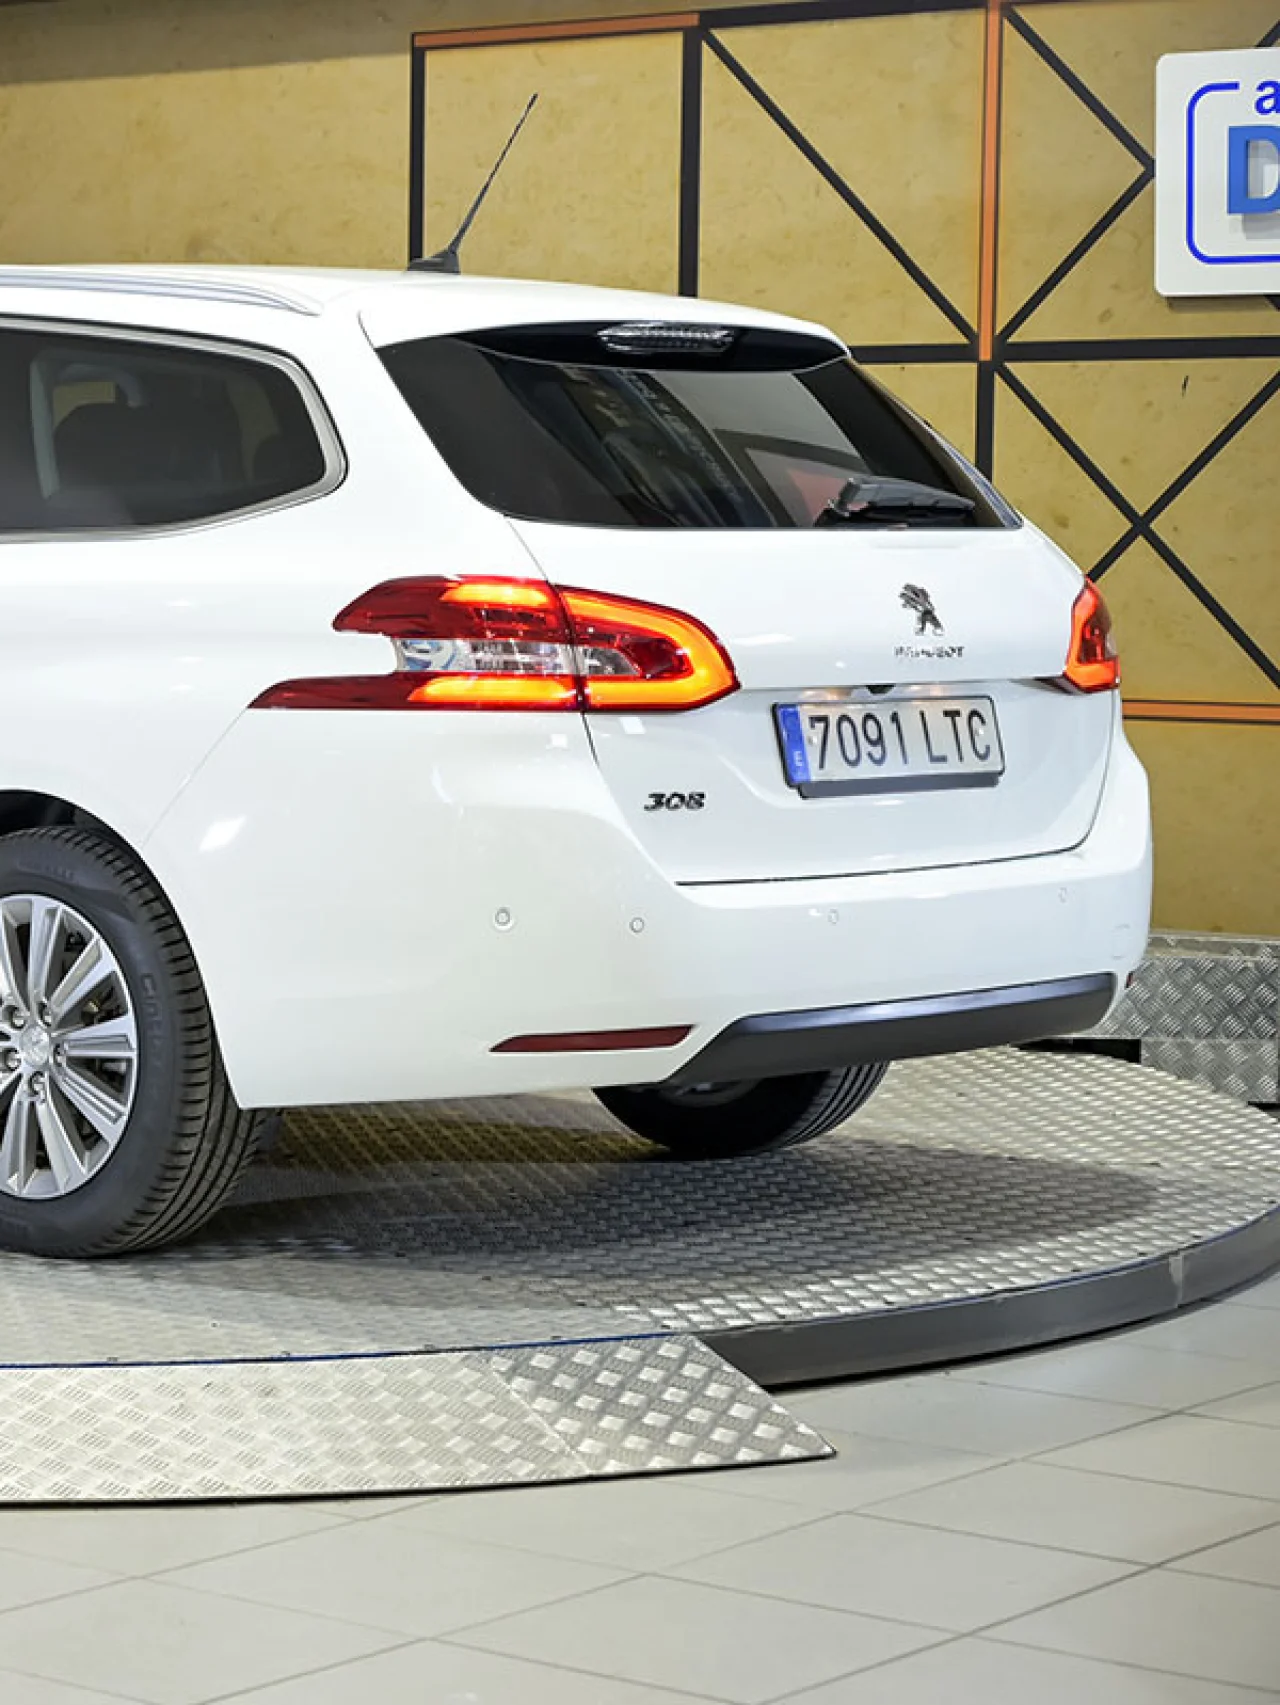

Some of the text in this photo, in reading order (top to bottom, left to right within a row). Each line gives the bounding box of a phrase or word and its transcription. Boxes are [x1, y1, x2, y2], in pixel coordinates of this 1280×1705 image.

[893, 645, 965, 659] PEOT
[807, 708, 991, 770] 7091 LTC
[643, 791, 706, 811] 308
